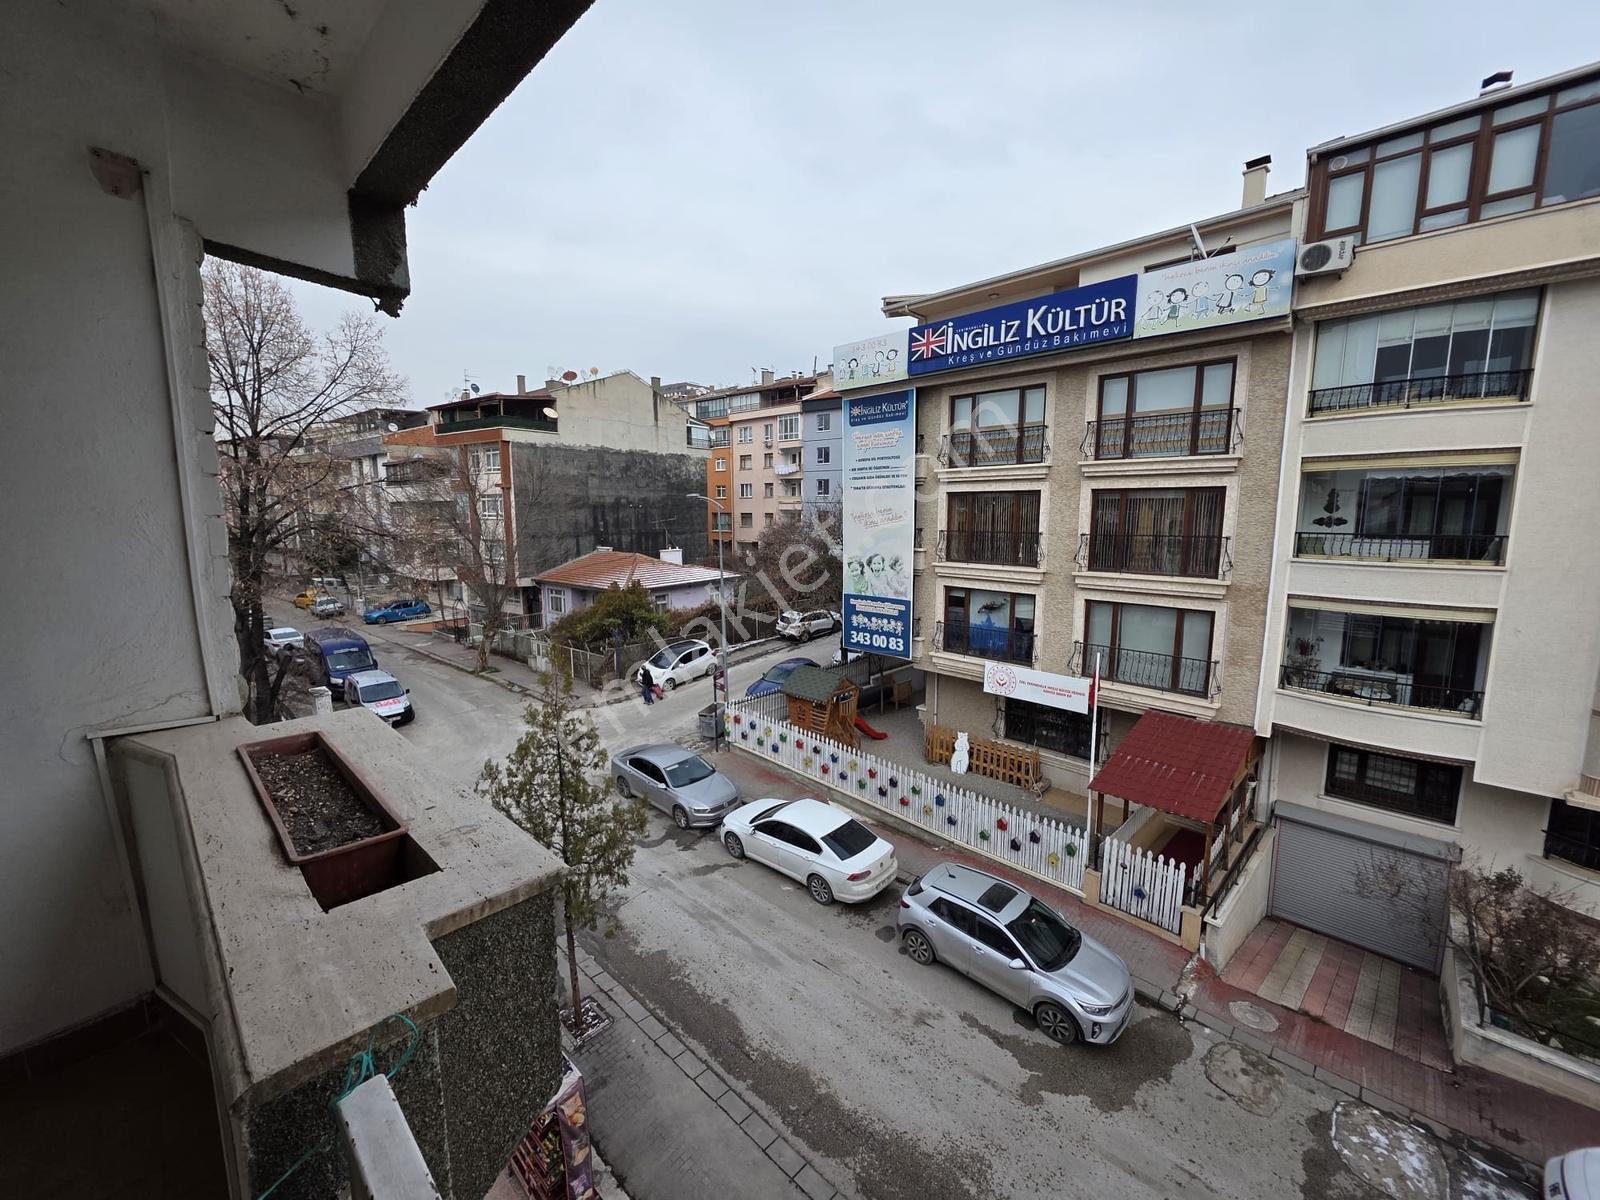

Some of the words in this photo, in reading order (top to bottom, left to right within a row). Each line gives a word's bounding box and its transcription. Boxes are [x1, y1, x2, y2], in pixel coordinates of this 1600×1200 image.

[946, 319, 1021, 354] İNGİLİZ
[1026, 297, 1127, 339] KÜLTÜR
[948, 353, 975, 366] Kreş
[979, 350, 992, 360] ve
[997, 338, 1048, 356] Gündüz
[1053, 324, 1128, 346] Bakımevi
[850, 631, 871, 645] 343
[872, 634, 887, 648] 00
[888, 637, 904, 651] 83
